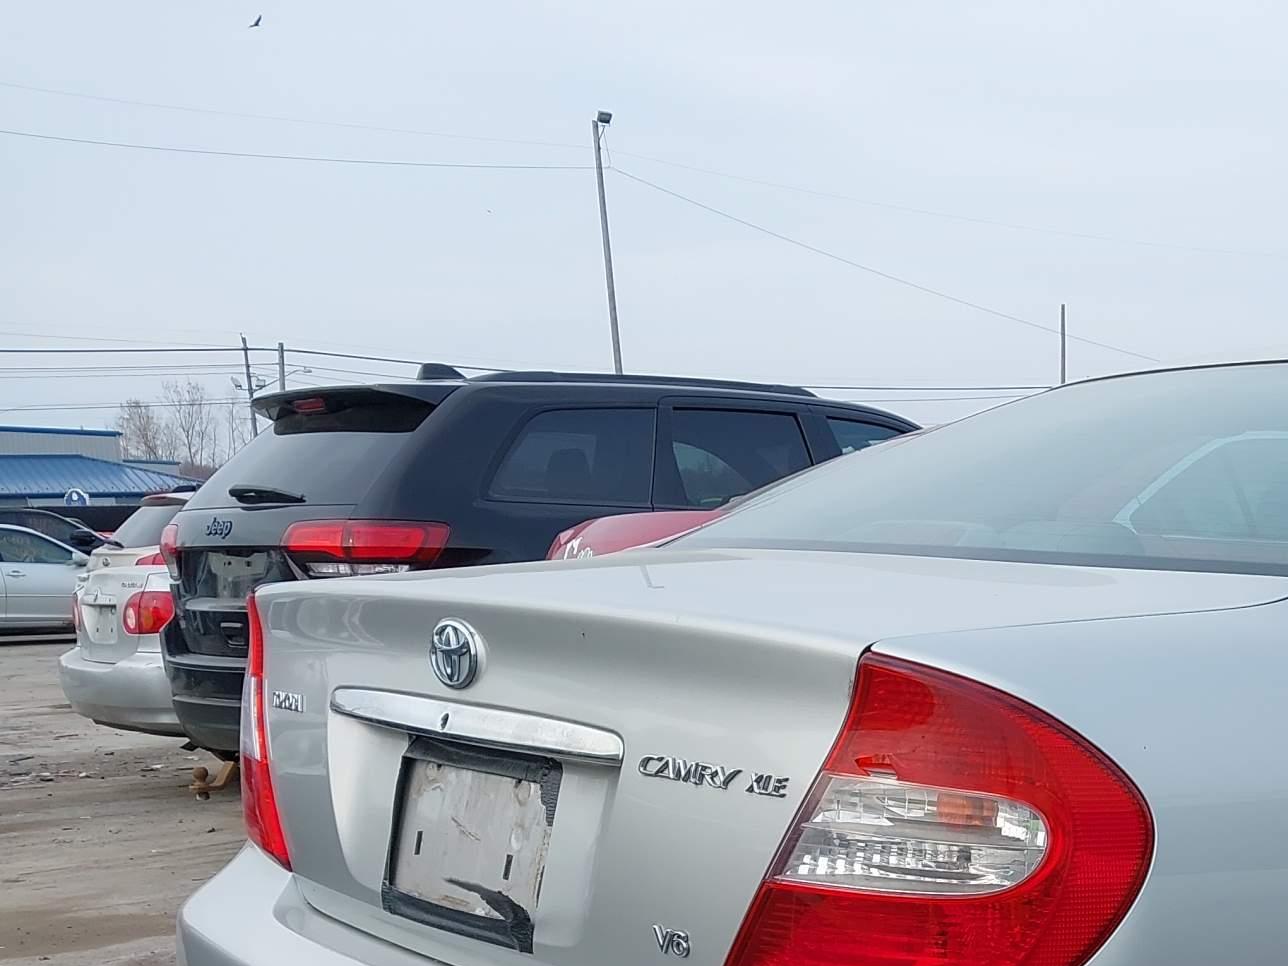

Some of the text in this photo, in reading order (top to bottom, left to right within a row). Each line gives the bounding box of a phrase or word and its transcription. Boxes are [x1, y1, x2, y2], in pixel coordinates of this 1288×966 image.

[205, 516, 233, 540] Jeep
[638, 754, 790, 798] CAMRY XLE
[652, 924, 691, 958] V6
